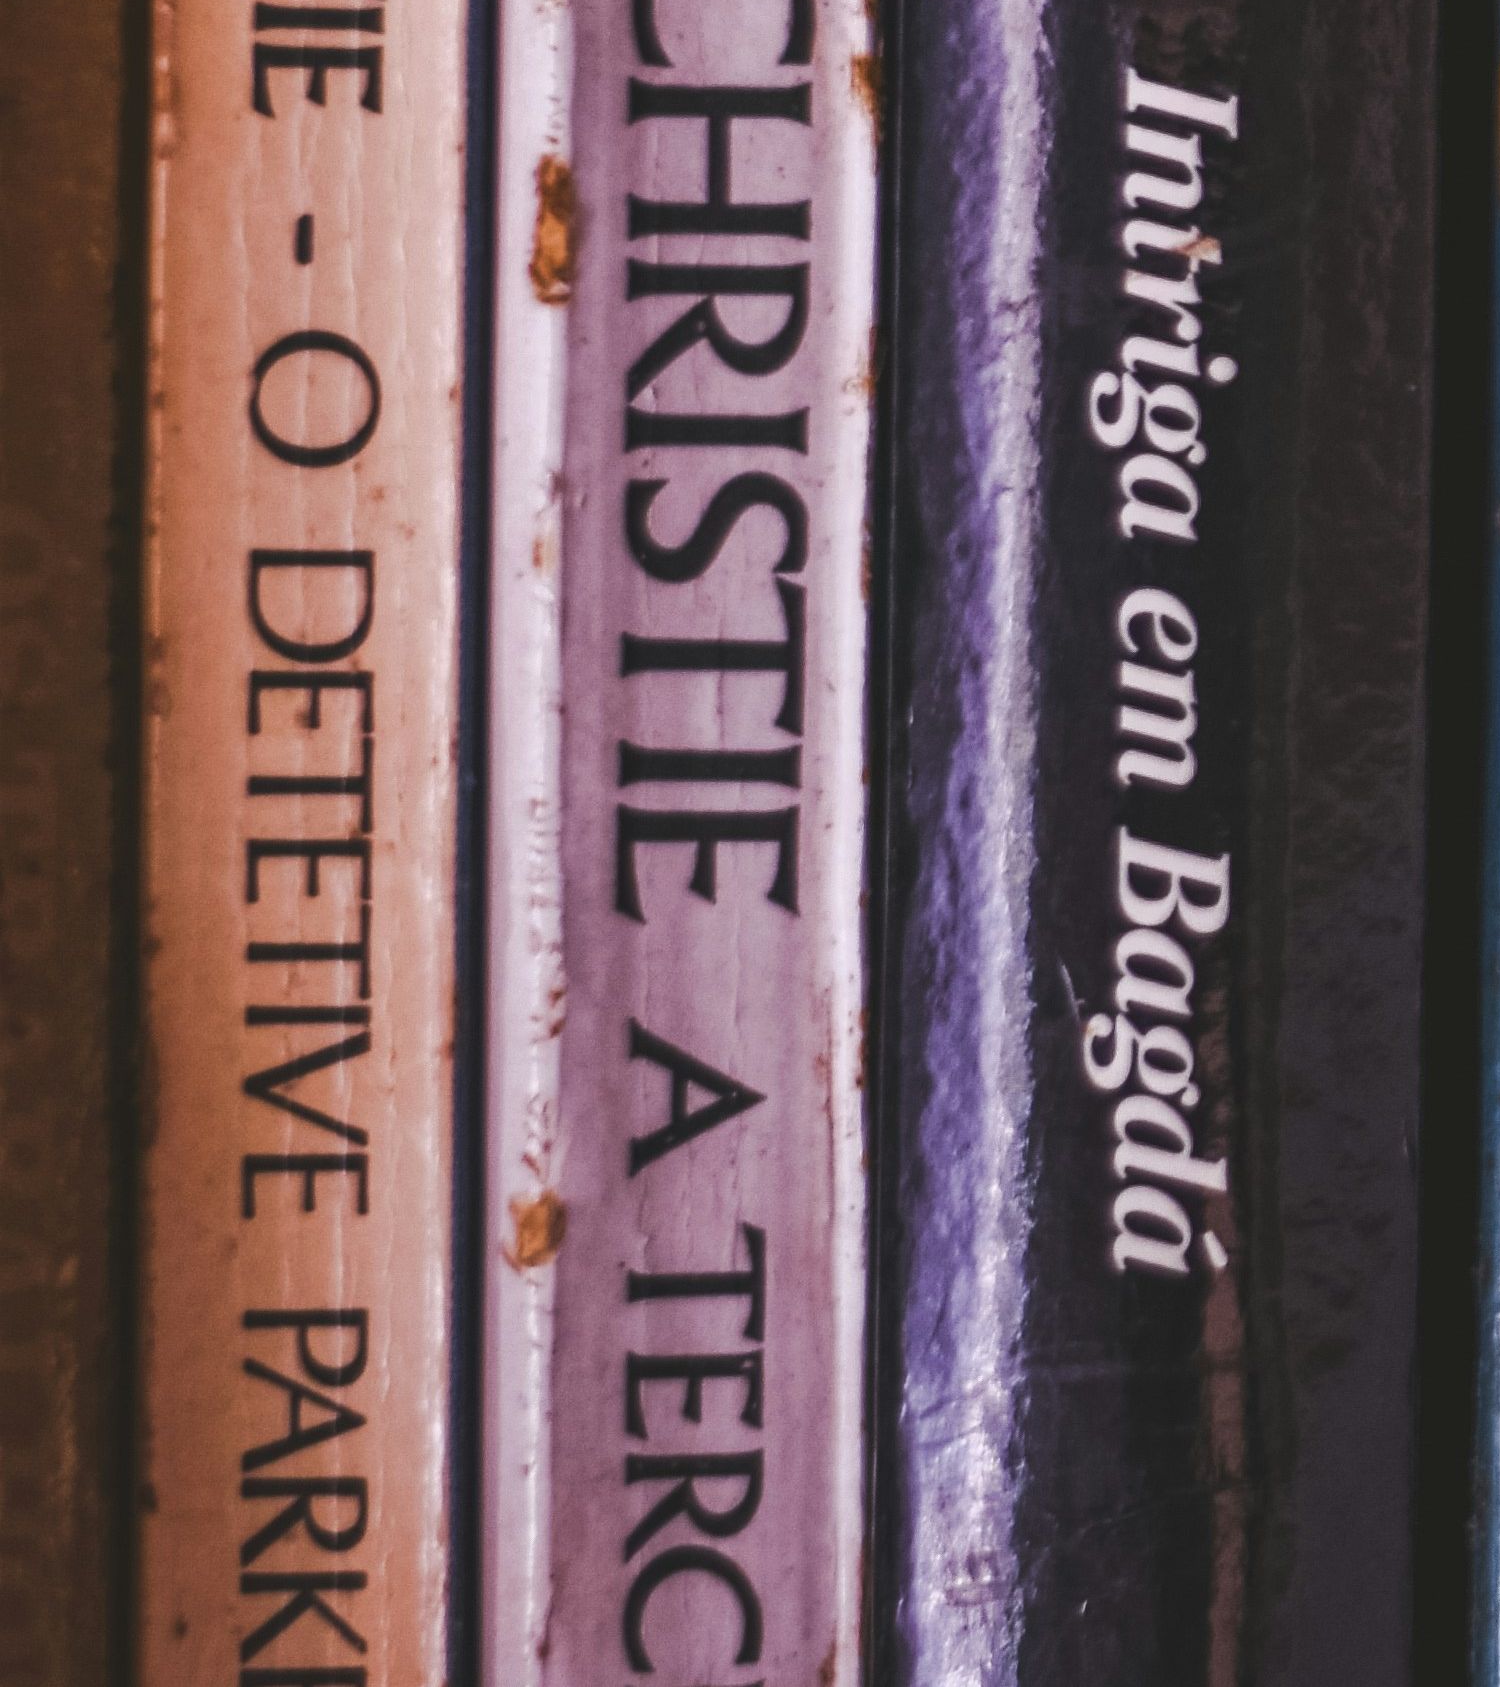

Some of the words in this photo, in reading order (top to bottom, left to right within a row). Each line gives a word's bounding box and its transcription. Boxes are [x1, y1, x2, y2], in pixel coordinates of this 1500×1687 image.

[248, 329, 381, 467] O
[1086, 67, 1238, 543] Intriga
[240, 550, 376, 1220] DETETIVE
[1118, 589, 1201, 791] em
[628, 1019, 766, 1180] A
[1083, 827, 1233, 1278] Bagdá
[620, 1222, 767, 1687] TERC
